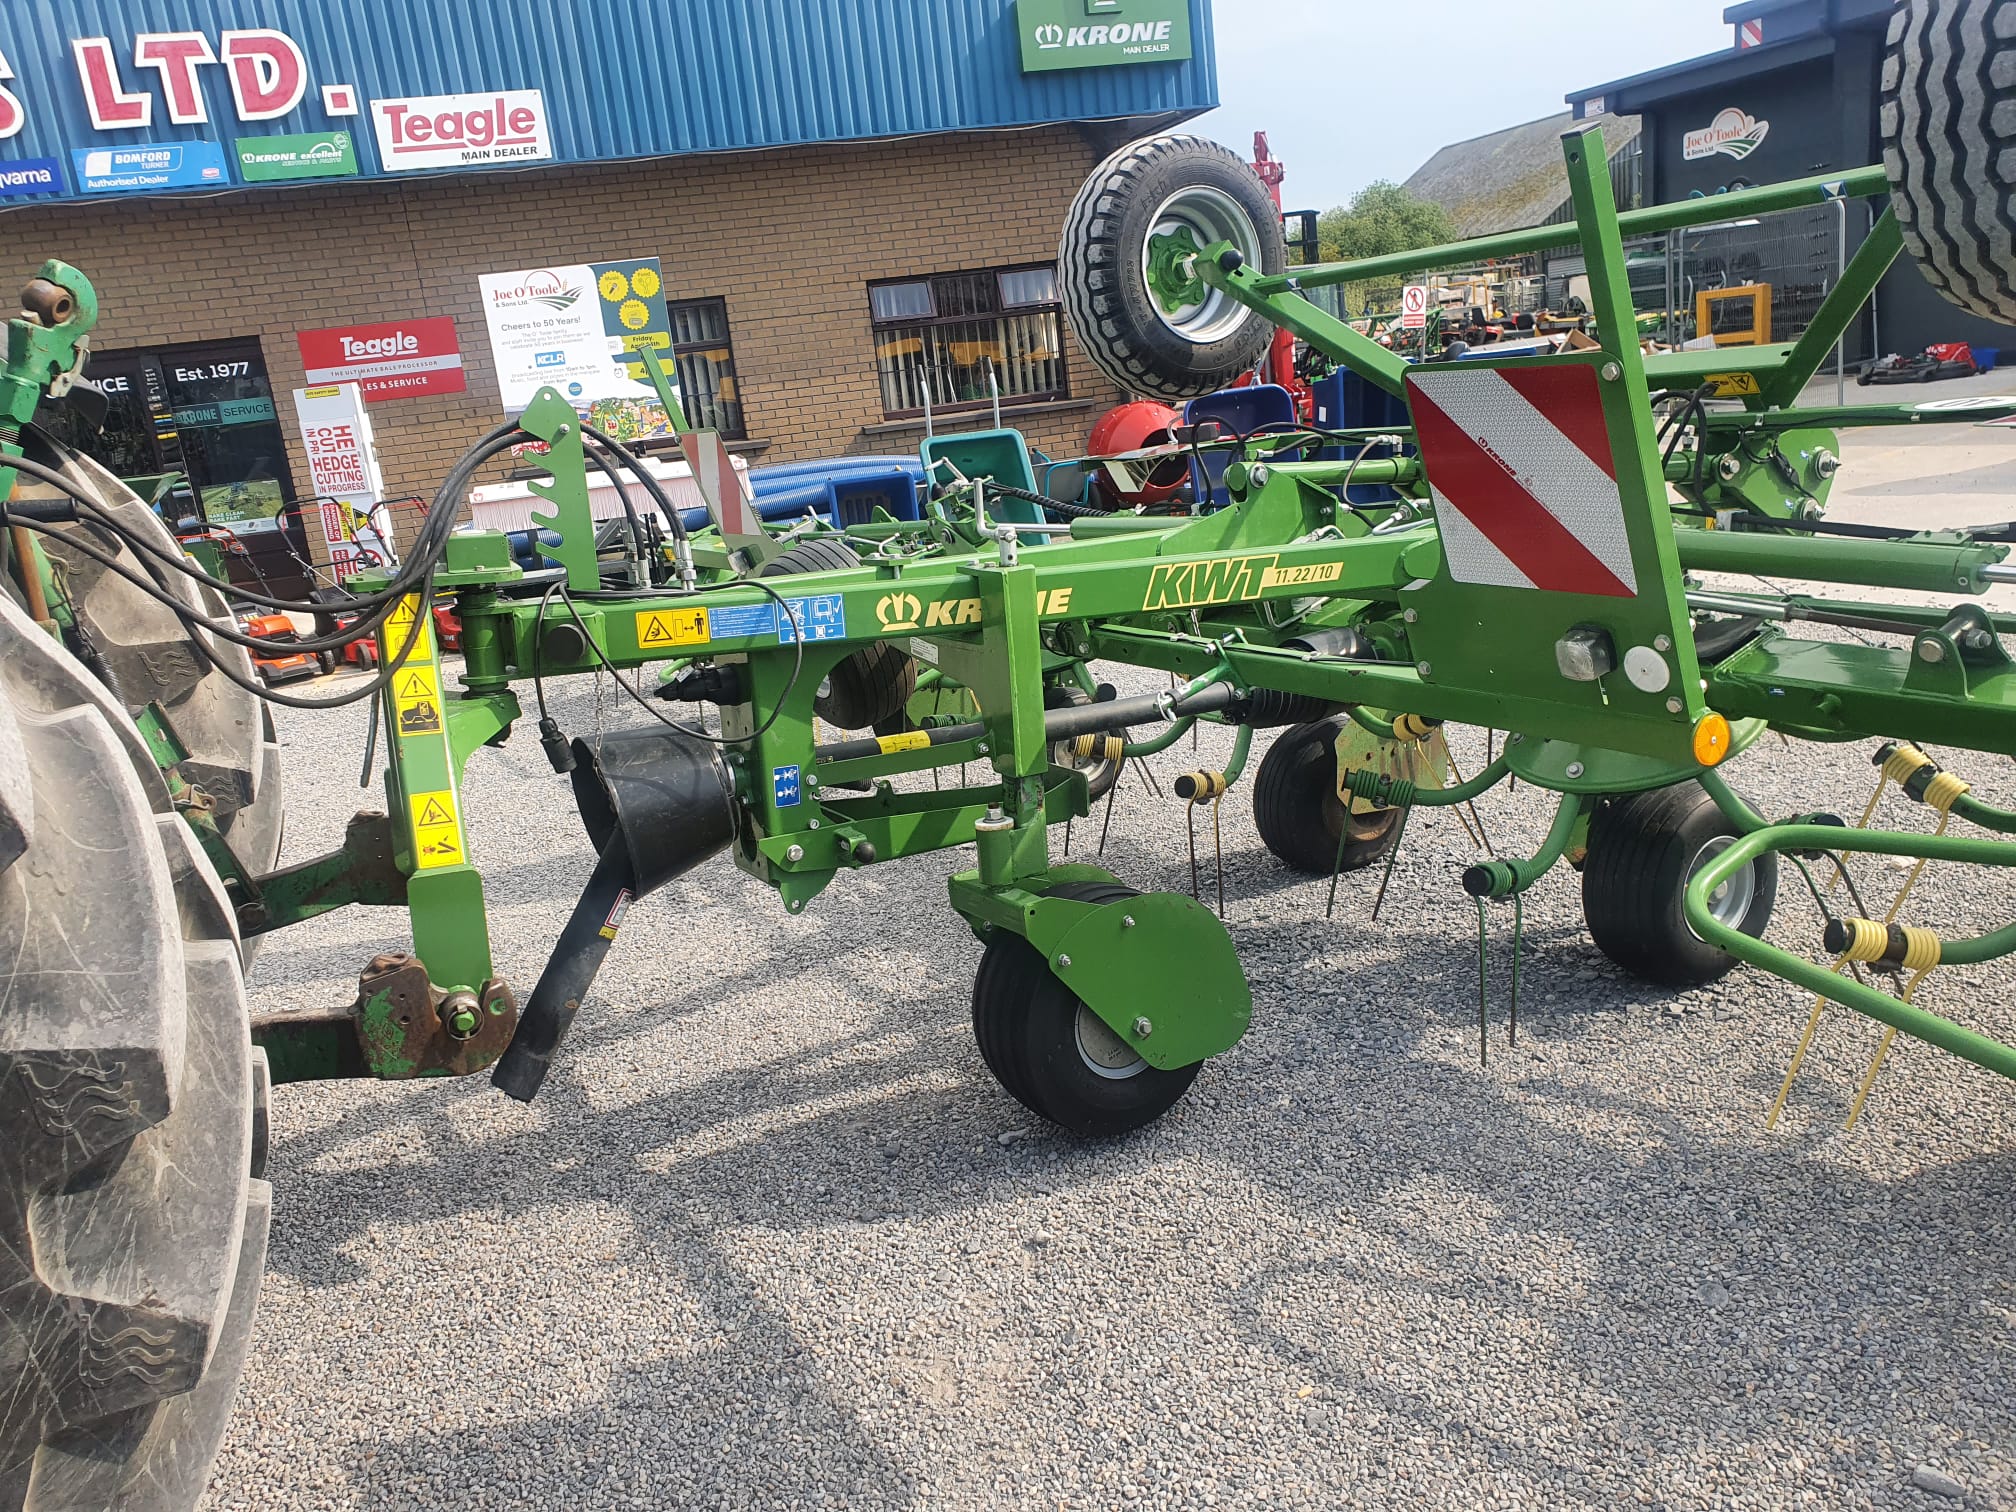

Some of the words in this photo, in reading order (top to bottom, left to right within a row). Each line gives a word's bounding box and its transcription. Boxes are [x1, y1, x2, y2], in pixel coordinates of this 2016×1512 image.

[1066, 20, 1172, 47] KRONE
[1123, 46, 1142, 55] MAIN
[1143, 44, 1170, 53] DEALER
[72, 28, 359, 131] LTD.
[382, 98, 536, 147] Teagle
[1686, 136, 1702, 149] Joe
[114, 151, 171, 165] BOMFORD
[256, 152, 297, 163] KRONE
[300, 150, 343, 160] excellent
[461, 150, 491, 160] MAIN
[494, 146, 538, 158] DEALER
[141, 162, 170, 170] TURNER
[87, 176, 139, 189] Authorised
[139, 174, 169, 185] Dealer
[493, 289, 513, 302] Joe
[501, 322, 531, 332] Cheers
[543, 318, 554, 327] 50
[555, 315, 581, 326] Years!
[340, 331, 418, 357] Teagle
[537, 353, 565, 364] KCLR
[174, 367, 209, 383] Est.
[209, 361, 250, 379] 1977
[330, 368, 344, 377] THE
[344, 366, 378, 376] ULTIMATE
[379, 364, 396, 372] BALE
[398, 360, 438, 370] PROCESSOR
[379, 381, 387, 390] &
[388, 376, 428, 388] SERVICE
[223, 403, 272, 417] SERVICE
[305, 428, 316, 438] IN
[312, 453, 361, 472] HEDGE
[1485, 447, 1518, 476] KRONE
[316, 469, 364, 485] CUTTING
[319, 485, 327, 494] IN
[328, 481, 366, 493] PROGRESS
[323, 505, 334, 540] DROWNING
[329, 503, 339, 530] DANGER
[334, 530, 341, 540] OF
[1142, 553, 1280, 611] KWT
[1275, 564, 1335, 585] 11.22/10
[924, 587, 1073, 628] KRE
